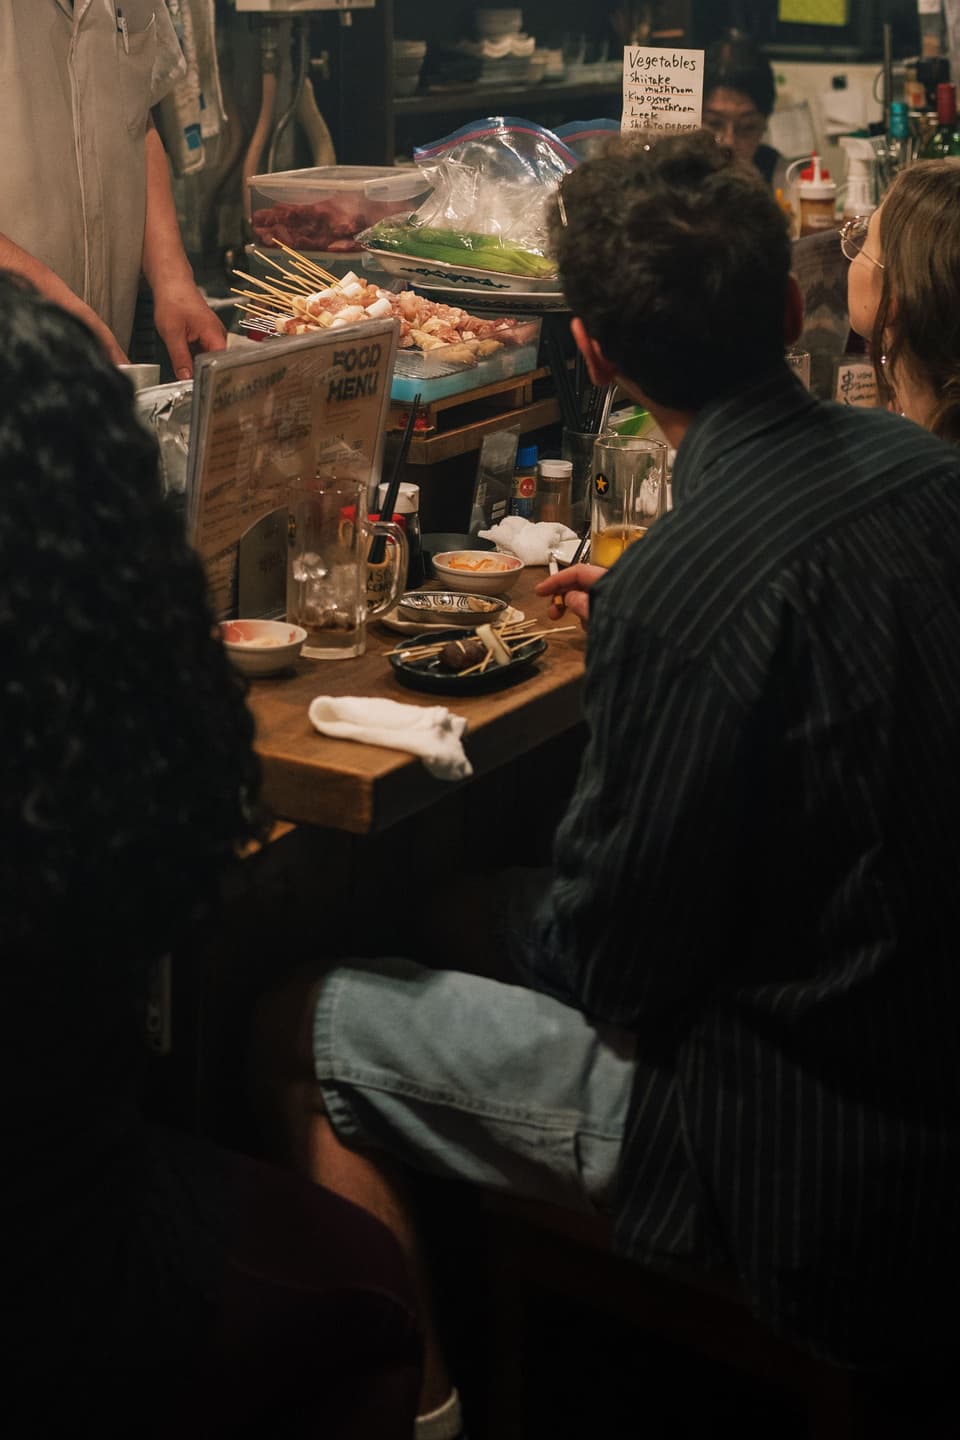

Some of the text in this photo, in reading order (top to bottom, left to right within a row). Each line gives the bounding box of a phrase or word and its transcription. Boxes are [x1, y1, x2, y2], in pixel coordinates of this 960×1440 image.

[629, 49, 697, 71] Vegetables
[630, 70, 671, 86] Shiitake
[628, 90, 645, 105] King
[645, 85, 694, 94] mushroom
[630, 106, 658, 119] Leek
[332, 343, 382, 372] FOOD
[326, 372, 380, 404] MENU
